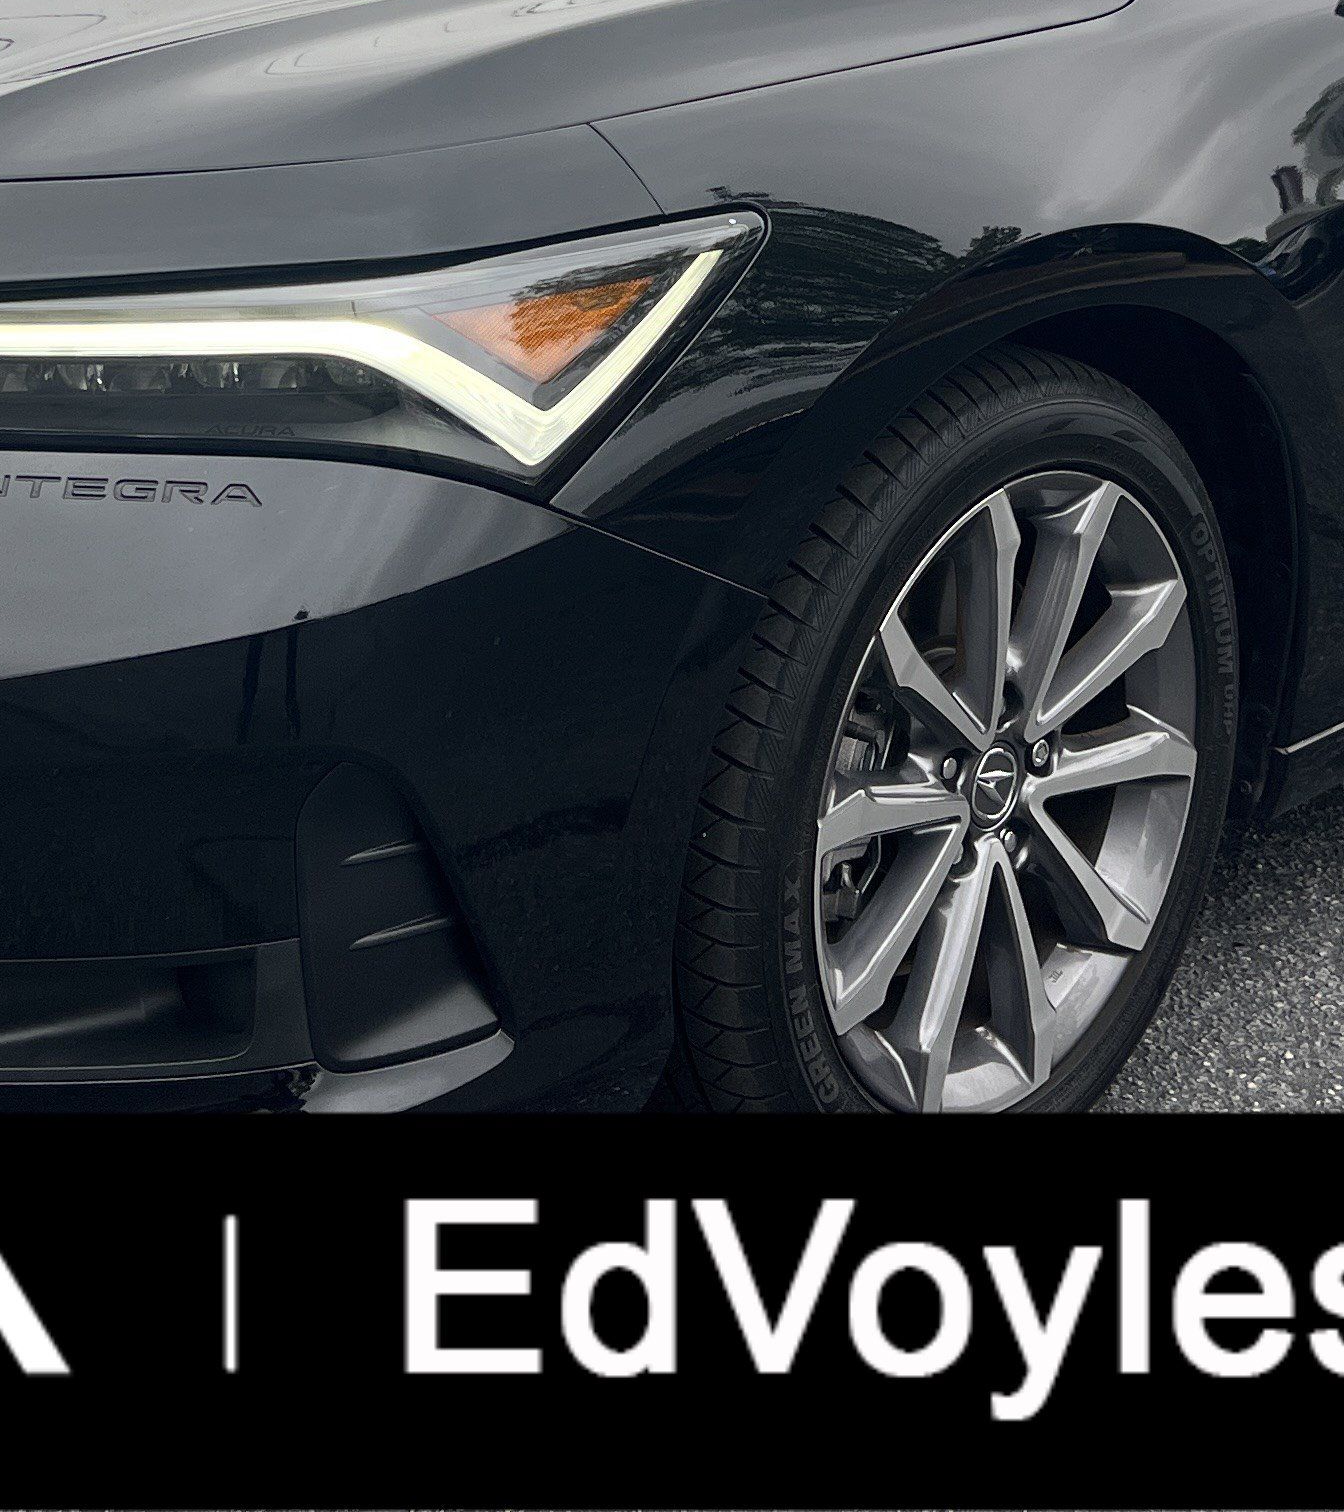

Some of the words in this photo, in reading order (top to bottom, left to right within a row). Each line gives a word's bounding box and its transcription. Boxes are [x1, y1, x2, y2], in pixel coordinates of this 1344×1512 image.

[1190, 519, 1235, 675] OPTIMUM
[783, 875, 804, 975] MAX
[788, 983, 841, 1105] GREEN
